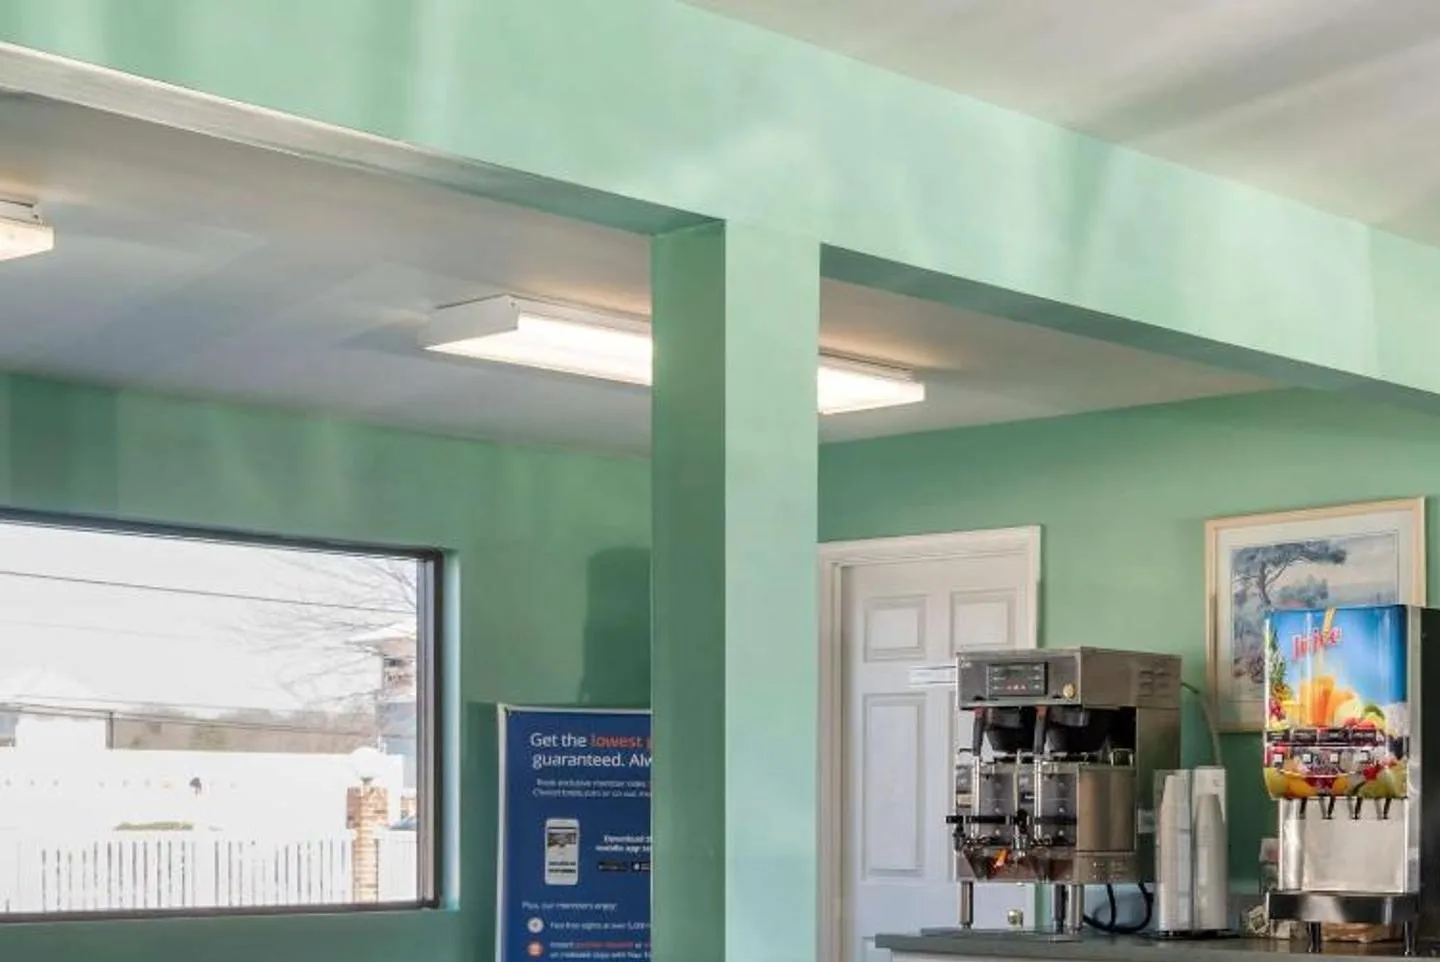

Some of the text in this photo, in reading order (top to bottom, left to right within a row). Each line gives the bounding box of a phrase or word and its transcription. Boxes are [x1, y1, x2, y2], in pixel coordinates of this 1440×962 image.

[530, 732, 560, 748] Get
[561, 732, 587, 748] the
[590, 732, 643, 749] lowest
[532, 752, 625, 770] guaranteed.
